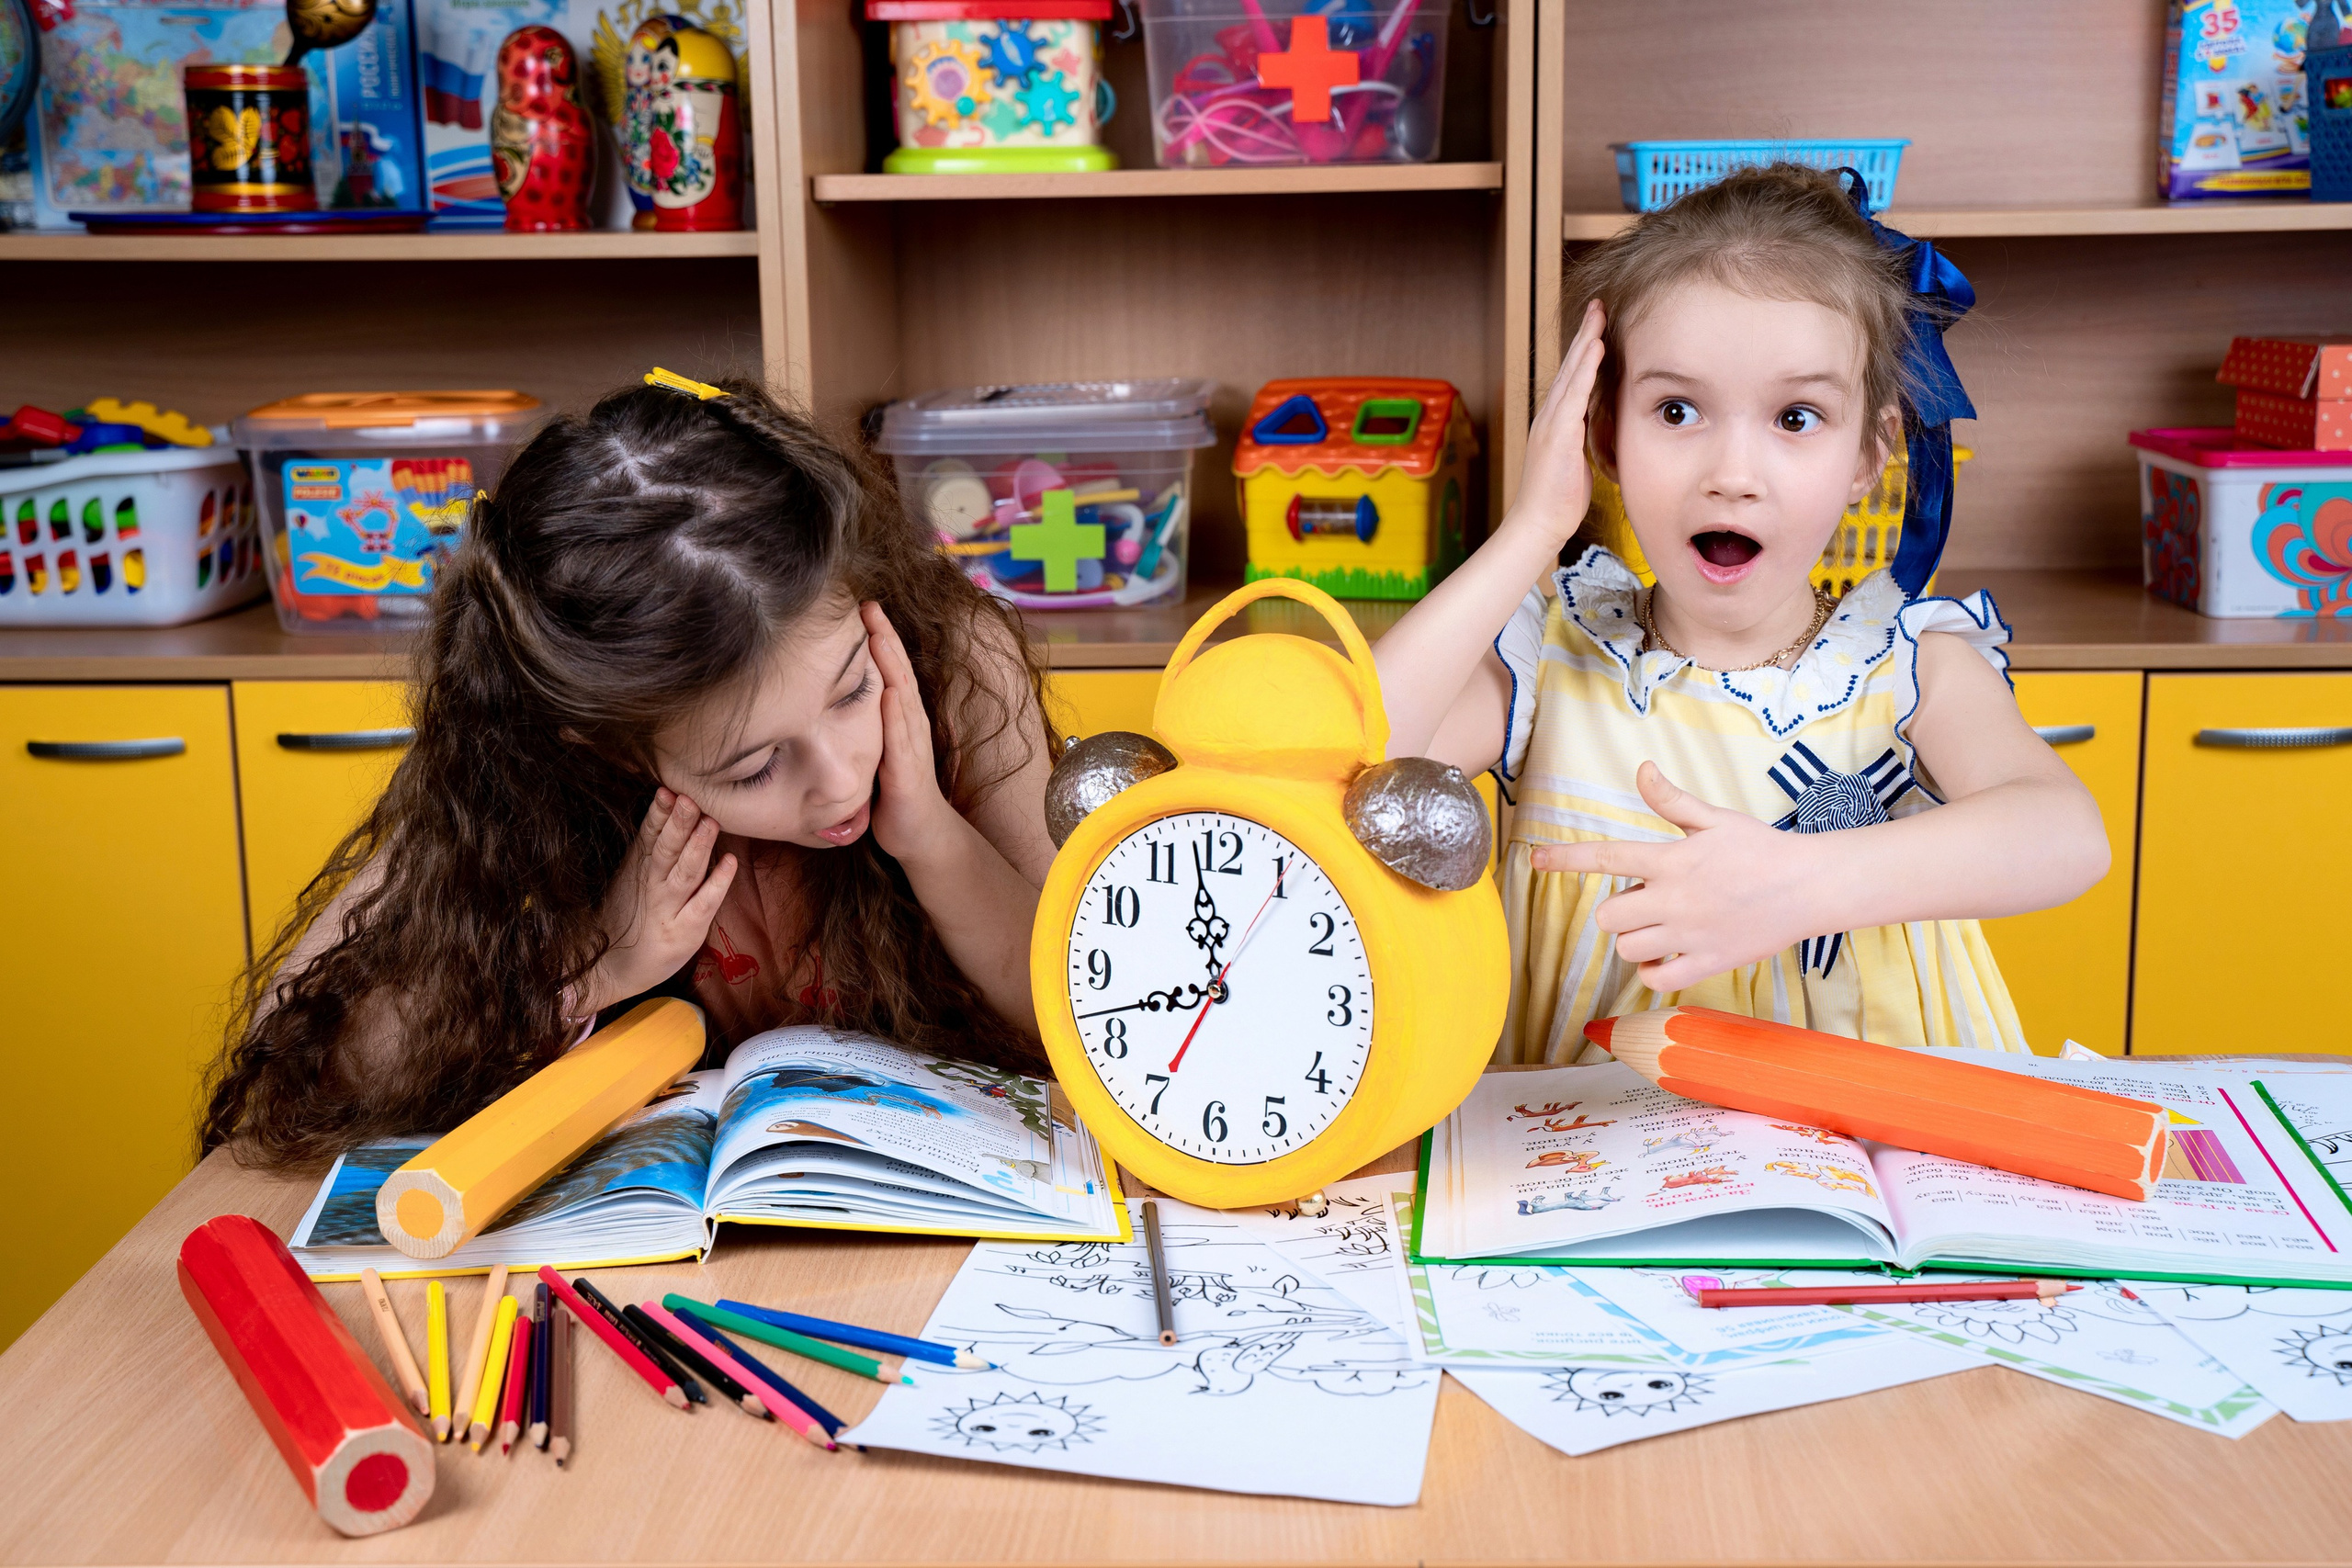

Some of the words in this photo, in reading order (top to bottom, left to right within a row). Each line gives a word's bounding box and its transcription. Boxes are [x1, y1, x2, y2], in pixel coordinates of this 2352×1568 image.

[2204, 9, 2238, 36] 35
[1201, 829, 1243, 875] 12
[1146, 841, 1179, 885] 11
[1271, 855, 1288, 899] 1
[1102, 885, 1140, 929] 10
[1308, 911, 1335, 957] 2
[1088, 948, 1112, 990] 9
[1327, 984, 1352, 1027] 3
[1104, 1018, 1128, 1059] 8
[758, 1052, 799, 1062] есть
[854, 1056, 900, 1070] какой
[1305, 1051, 1332, 1095] 4
[2093, 1076, 2153, 1085] стар-ше?
[1145, 1073, 1170, 1116] 7
[1608, 1092, 1672, 1107] -тё-нок
[1628, 1104, 1708, 1120] те-лё-нок
[1643, 1099, 1691, 1109] е-лят
[1203, 1100, 1228, 1143] 6
[1261, 1096, 1287, 1138] 5
[1629, 1111, 1725, 1128] коз-лё-нок.
[865, 1128, 911, 1143] всех?
[1643, 1122, 1691, 1133] ко-зы
[876, 1136, 922, 1153] рыба
[1521, 1132, 1597, 1146] у-тё-нок.
[1524, 1141, 1571, 1152] ут-ки
[917, 1143, 979, 1168] больше
[928, 1152, 978, 1173] Какая
[1650, 1150, 1741, 1167] те-лё-нок.
[1776, 1147, 1865, 1168] ко-тё-нок.
[1779, 1153, 1846, 1164] кош-ки
[886, 1166, 935, 1179] рыбы
[1645, 1158, 1724, 1174] ко-ро-вы
[1510, 1168, 1629, 1189] же-ре-бё-нок.
[1518, 1178, 1600, 1194] ло-ша-ди
[1724, 1181, 1755, 1190] кто
[1905, 1173, 1969, 1184] Од-но-го
[873, 1182, 930, 1196] самом
[1641, 1191, 1692, 1203] ко-го.
[2204, 1198, 2260, 1207] на-шем
[2245, 1208, 2290, 1216] Сё-ма
[2096, 1226, 2127, 1235] лом
